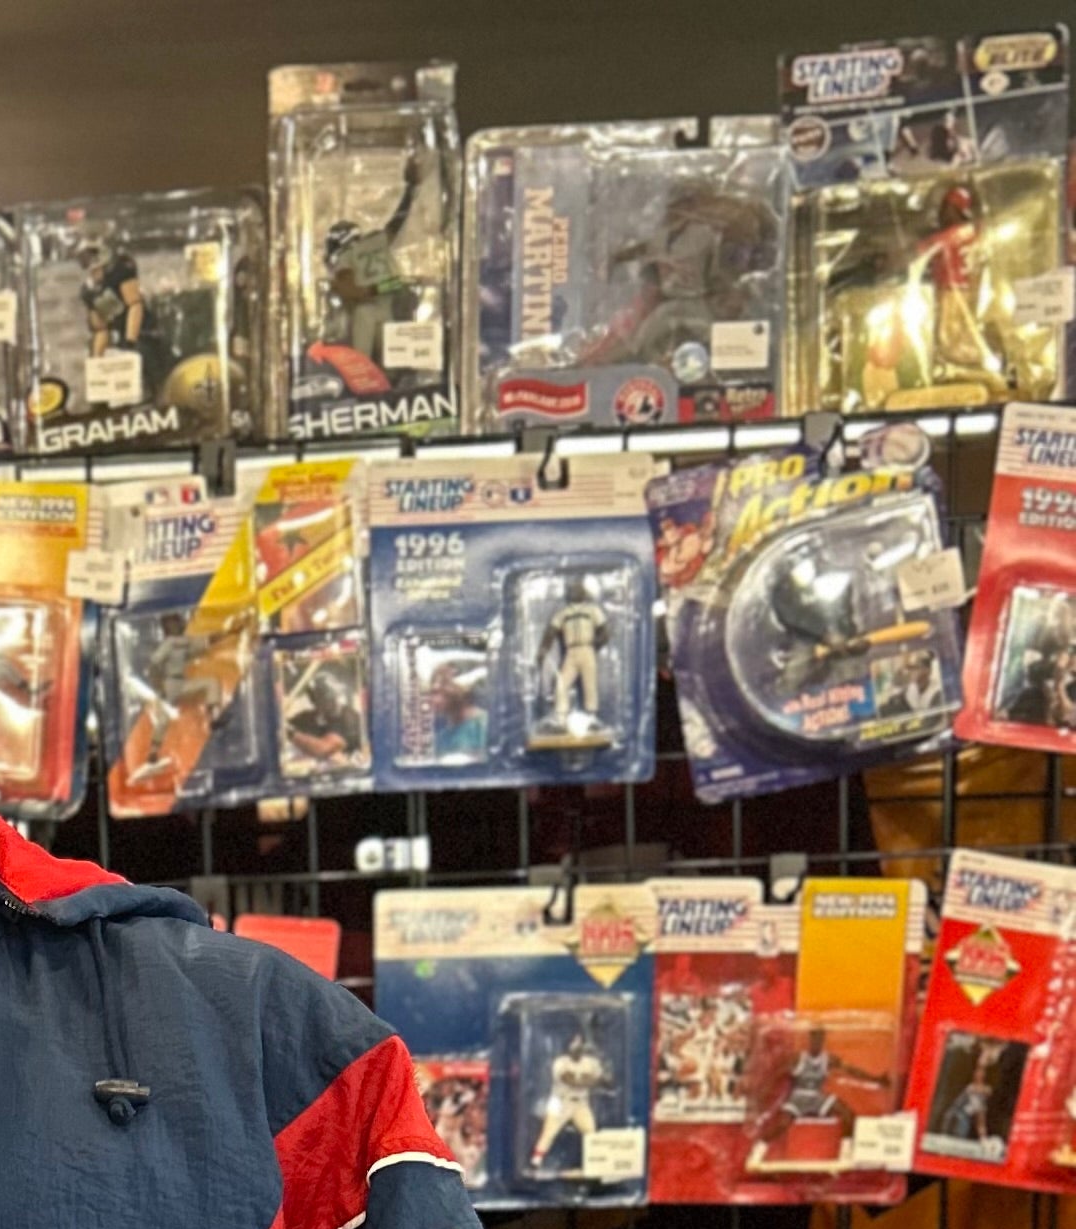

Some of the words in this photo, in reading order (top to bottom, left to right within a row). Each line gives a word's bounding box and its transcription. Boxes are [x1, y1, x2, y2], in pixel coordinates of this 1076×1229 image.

[792, 55, 899, 85] STARTING
[290, 391, 458, 438] SHERMAN
[40, 408, 179, 451] GRAHAM
[384, 477, 473, 500] STARTING
[728, 454, 805, 498] PRO
[398, 491, 464, 513] LINEUP
[395, 532, 465, 558] 1996
[658, 898, 747, 917] TARTING
